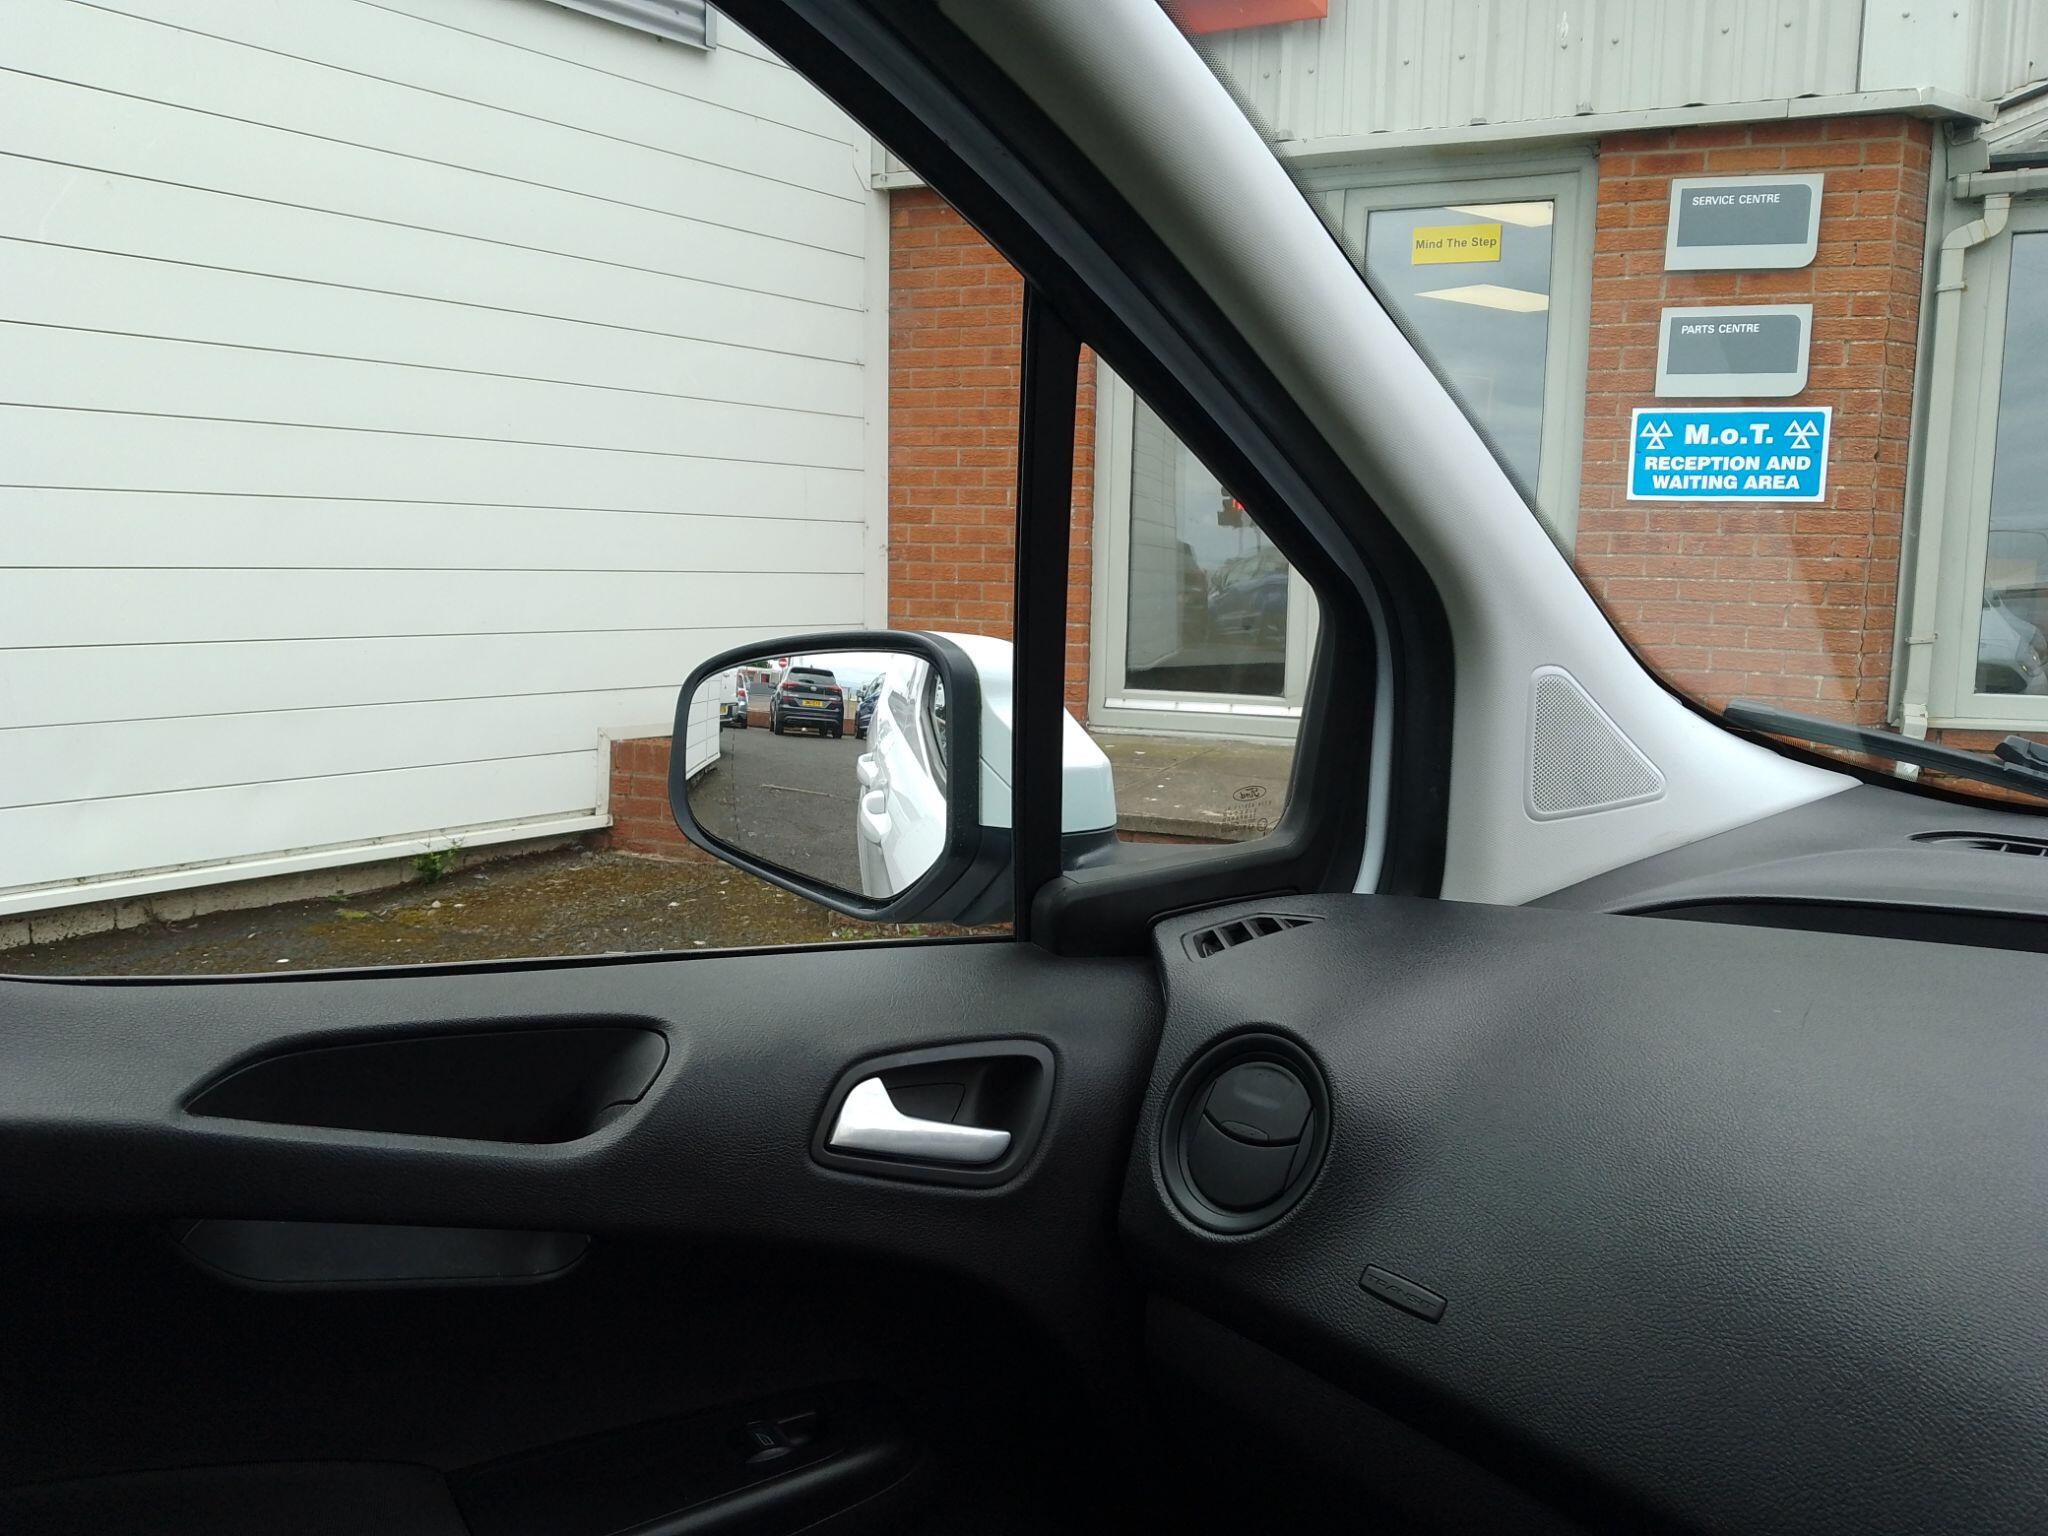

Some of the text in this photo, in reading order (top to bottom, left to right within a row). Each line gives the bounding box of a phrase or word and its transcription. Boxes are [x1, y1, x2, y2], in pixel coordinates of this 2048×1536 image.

[1692, 193, 1781, 206] SERVICE CENTRE
[1415, 236, 1497, 250] Mind The Step
[1681, 323, 1760, 335] PARTS CENTRE
[1684, 423, 1774, 445] M.o.T.
[1644, 455, 1811, 471] RECEPTION AND
[1652, 474, 1800, 490] WAITING AREA
